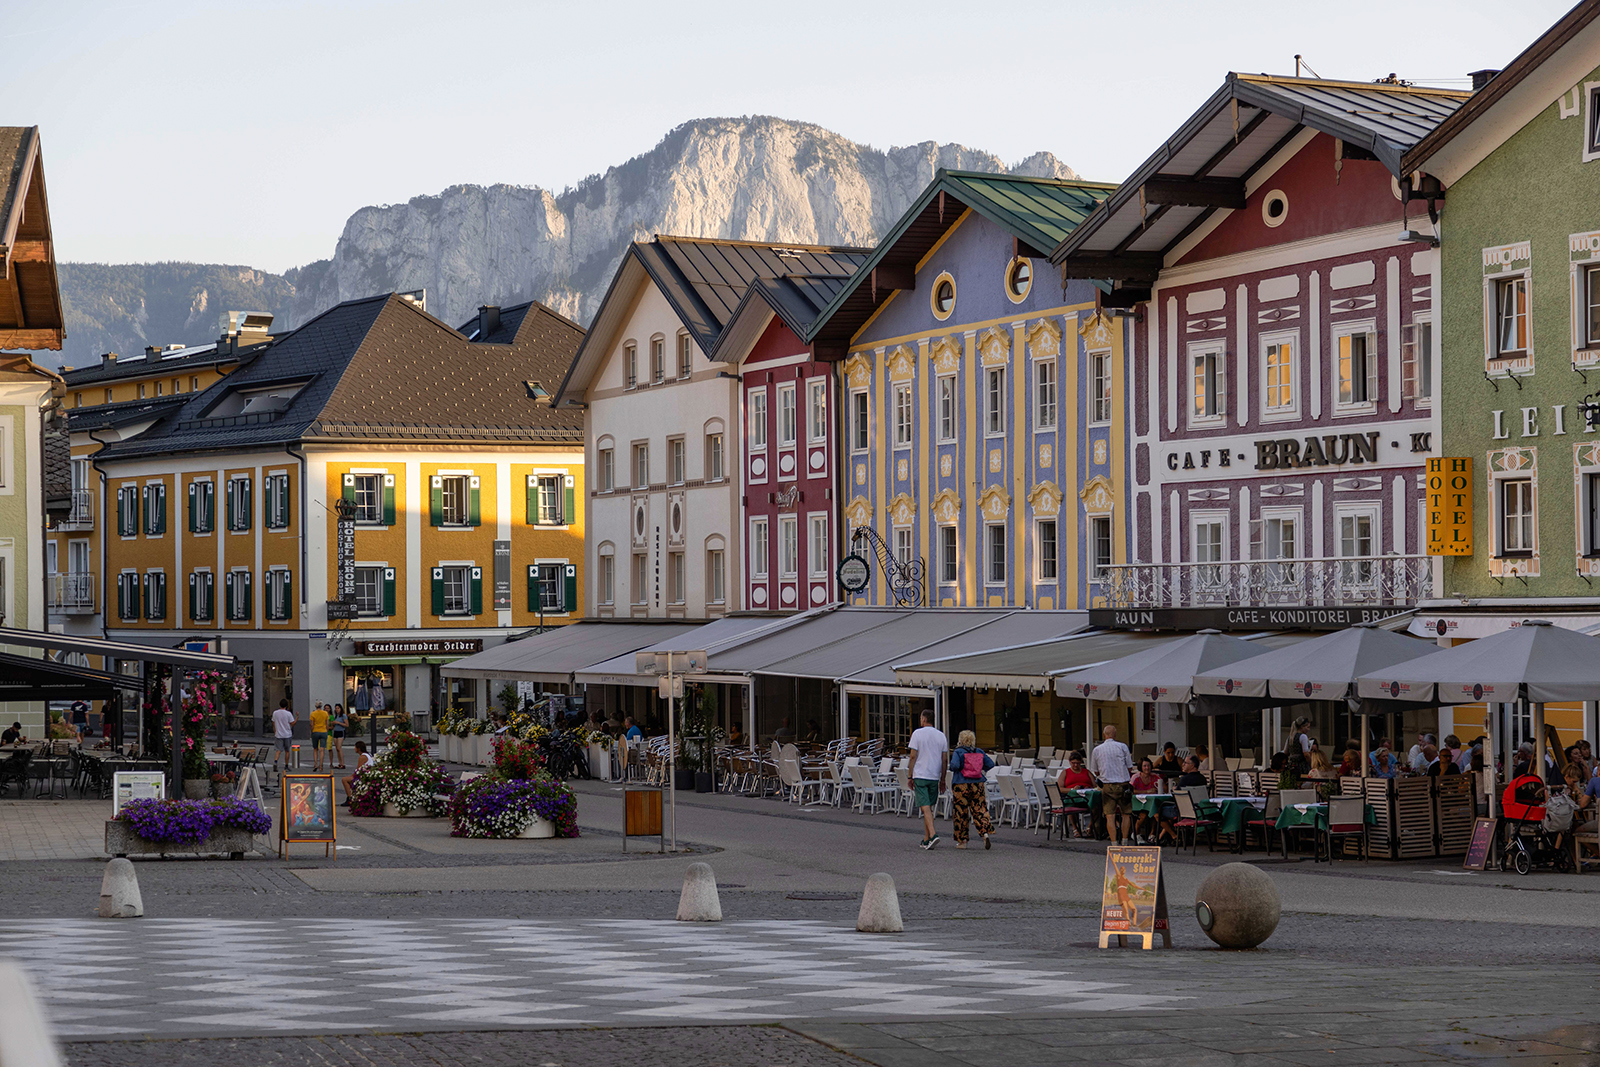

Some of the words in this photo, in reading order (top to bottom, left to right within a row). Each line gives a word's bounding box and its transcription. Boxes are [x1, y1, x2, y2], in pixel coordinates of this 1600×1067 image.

[1167, 448, 1231, 470] CAFE
[1254, 431, 1379, 470] BRAUN
[1429, 459, 1442, 542] HOTEL
[1451, 458, 1467, 542] HOTEL
[344, 521, 354, 556] HOTEL
[344, 559, 355, 594] KRONE
[1228, 611, 1258, 623] CAFE
[1270, 610, 1350, 623] KONDITOREI
[367, 642, 439, 652] Trachtenmoden
[1113, 853, 1156, 864] Wasserski-
[1132, 863, 1156, 873] Show
